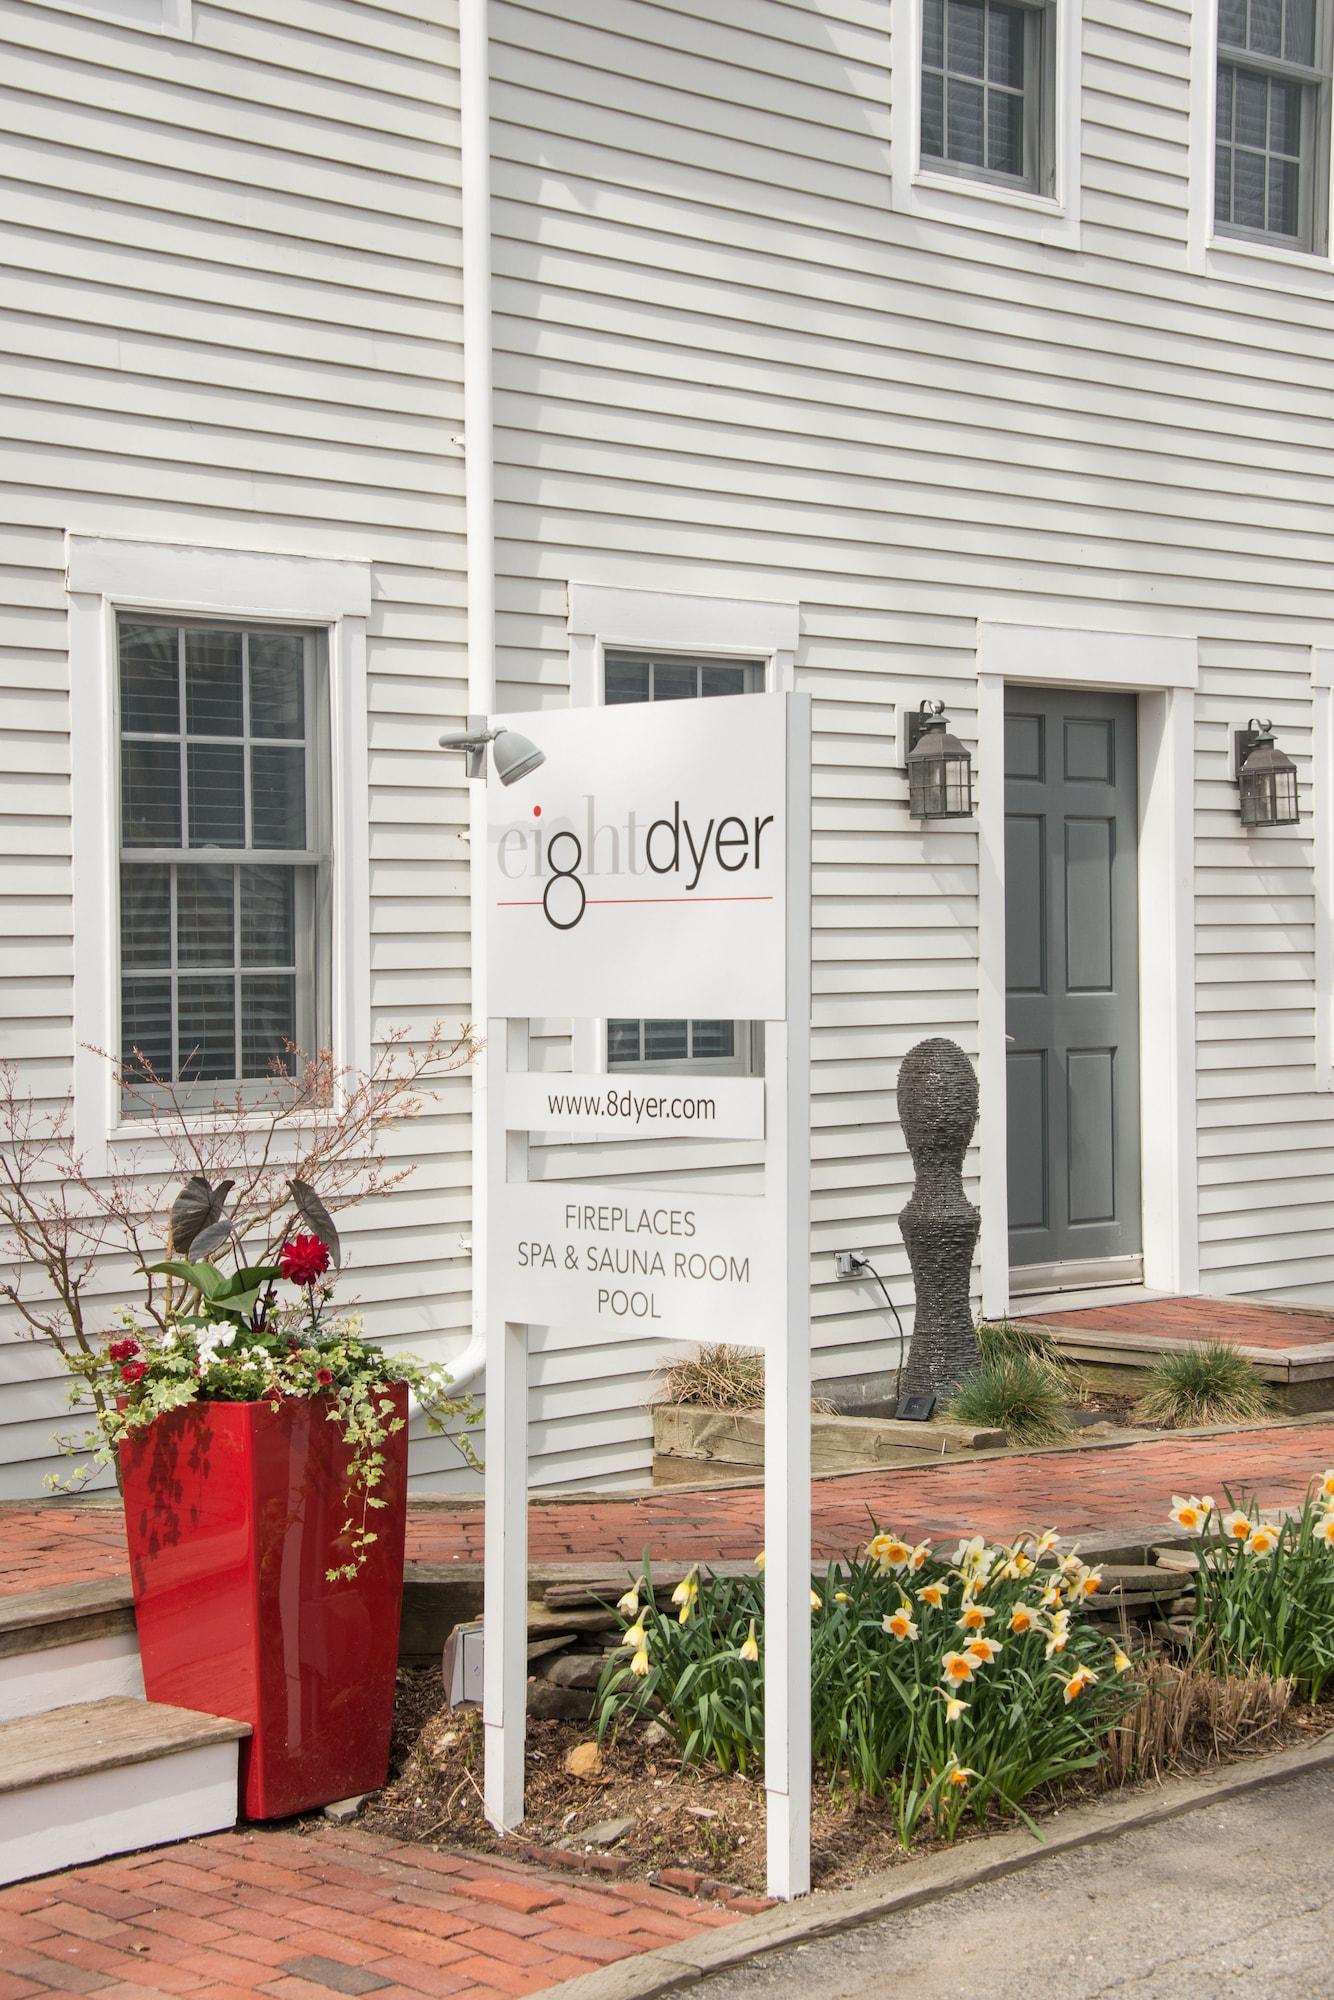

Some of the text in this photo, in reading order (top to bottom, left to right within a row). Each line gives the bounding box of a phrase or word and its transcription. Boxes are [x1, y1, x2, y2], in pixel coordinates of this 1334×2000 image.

[548, 1090, 716, 1124] www.8dyer.com
[565, 1204, 697, 1237] FIREPLACES
[517, 1241, 750, 1283] SPA & SAUNA ROOM
[597, 1289, 662, 1319] POOL
